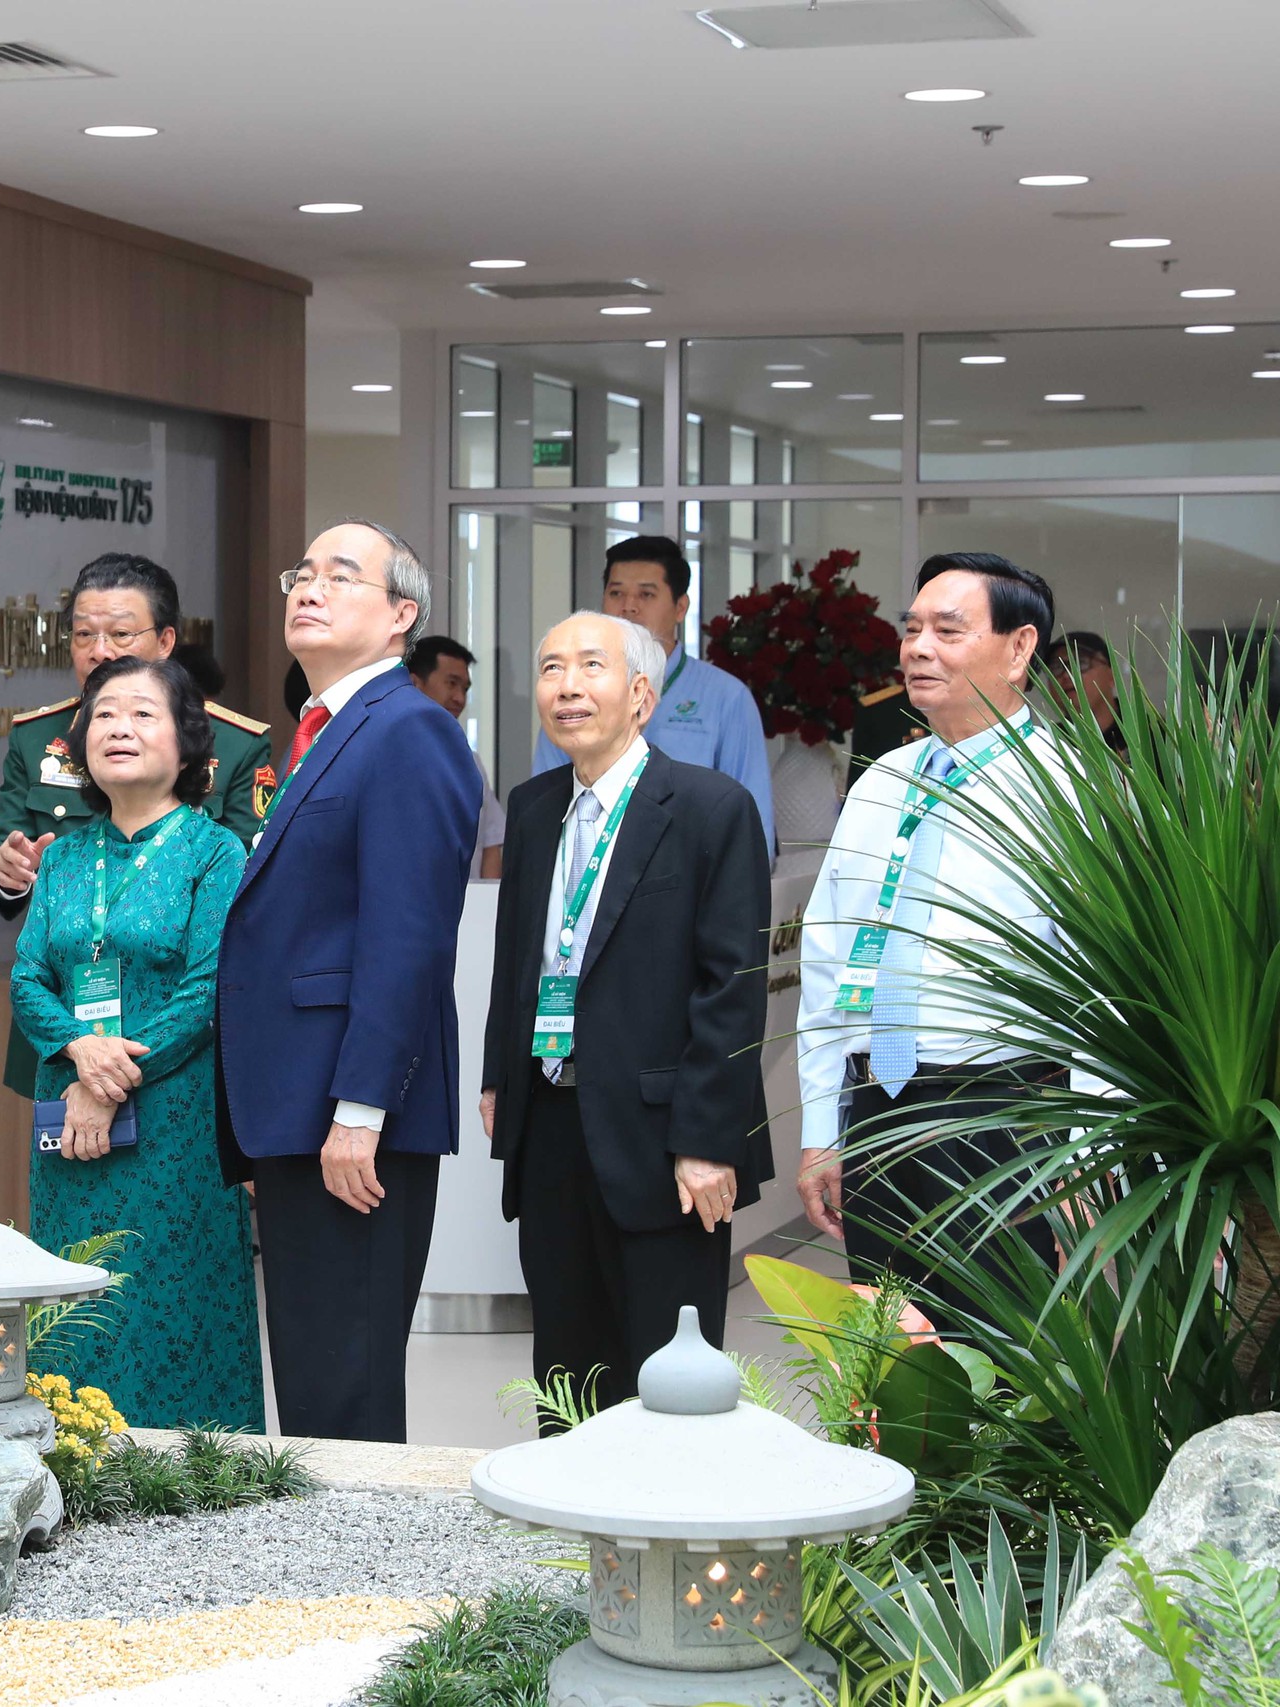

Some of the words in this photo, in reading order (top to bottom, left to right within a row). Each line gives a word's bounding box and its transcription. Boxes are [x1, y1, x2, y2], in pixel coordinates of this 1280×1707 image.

[14, 465, 65, 482] MILITARY
[68, 473, 118, 490] HOSPITAL
[120, 477, 153, 526] 175
